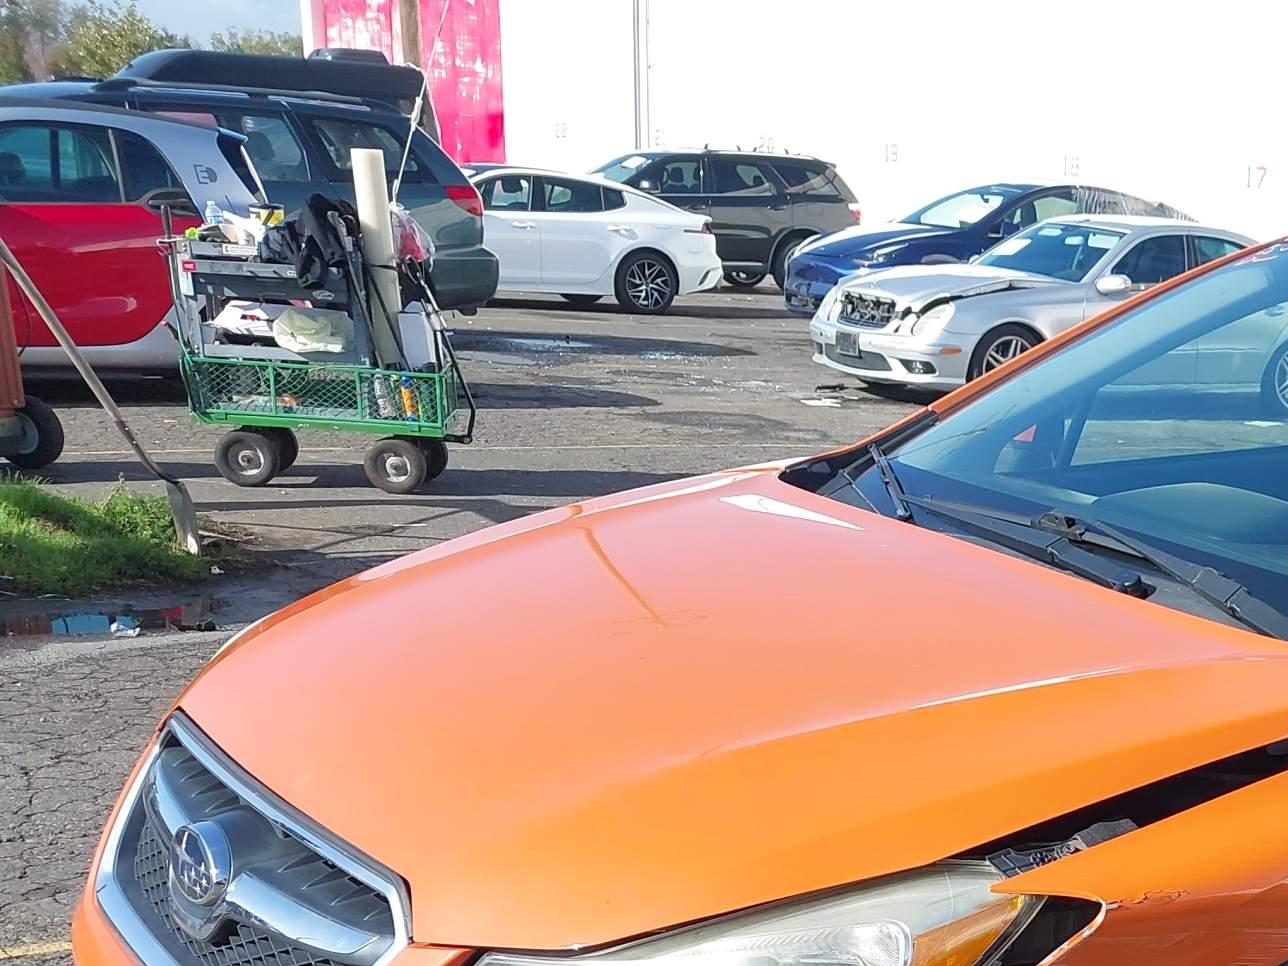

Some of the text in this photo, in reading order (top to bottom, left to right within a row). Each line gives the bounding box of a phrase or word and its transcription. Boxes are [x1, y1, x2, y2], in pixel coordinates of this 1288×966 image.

[885, 143, 898, 162] 19
[1063, 154, 1080, 176] 18
[1246, 165, 1267, 189] 17
